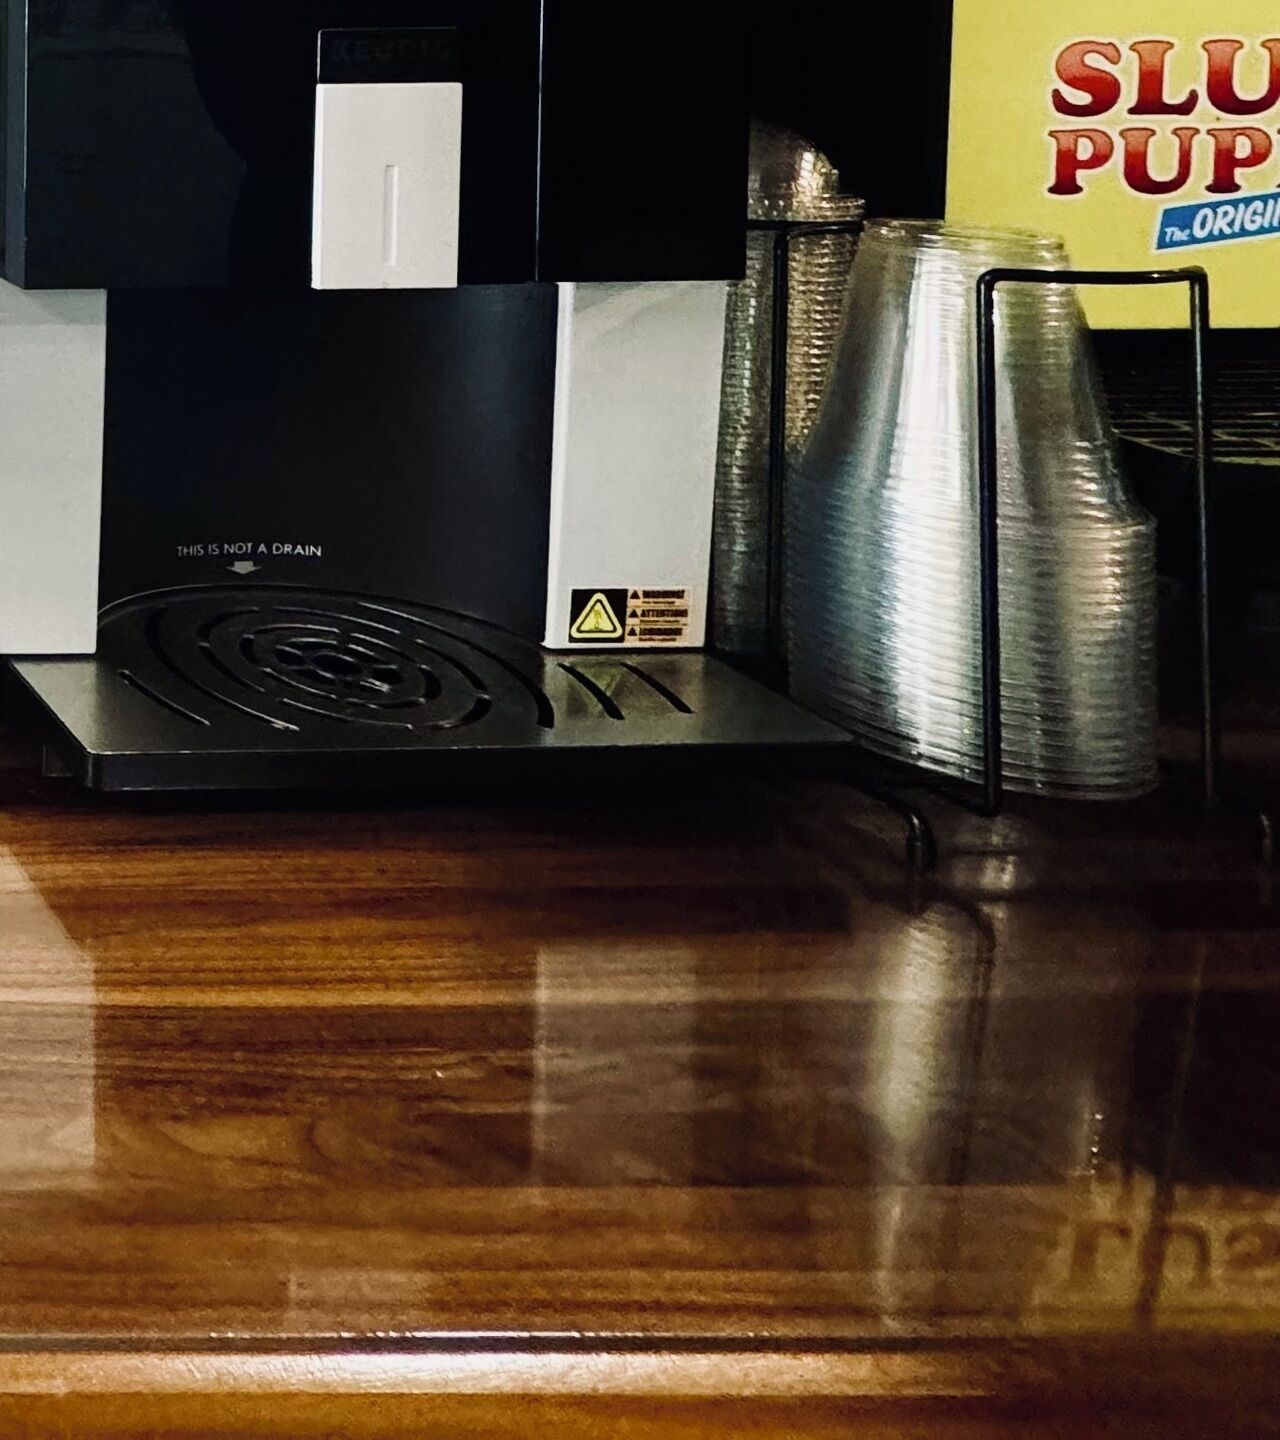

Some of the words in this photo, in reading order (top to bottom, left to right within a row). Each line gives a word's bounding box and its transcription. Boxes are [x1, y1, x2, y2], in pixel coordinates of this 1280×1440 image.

[1052, 39, 1280, 116] SLU
[1047, 126, 1280, 195] PUP
[1164, 227, 1191, 242] The
[177, 545, 203, 556] THIS
[208, 544, 218, 555] IS
[224, 542, 252, 553] NOT
[257, 543, 266, 553] A
[272, 543, 321, 556] DRAIN
